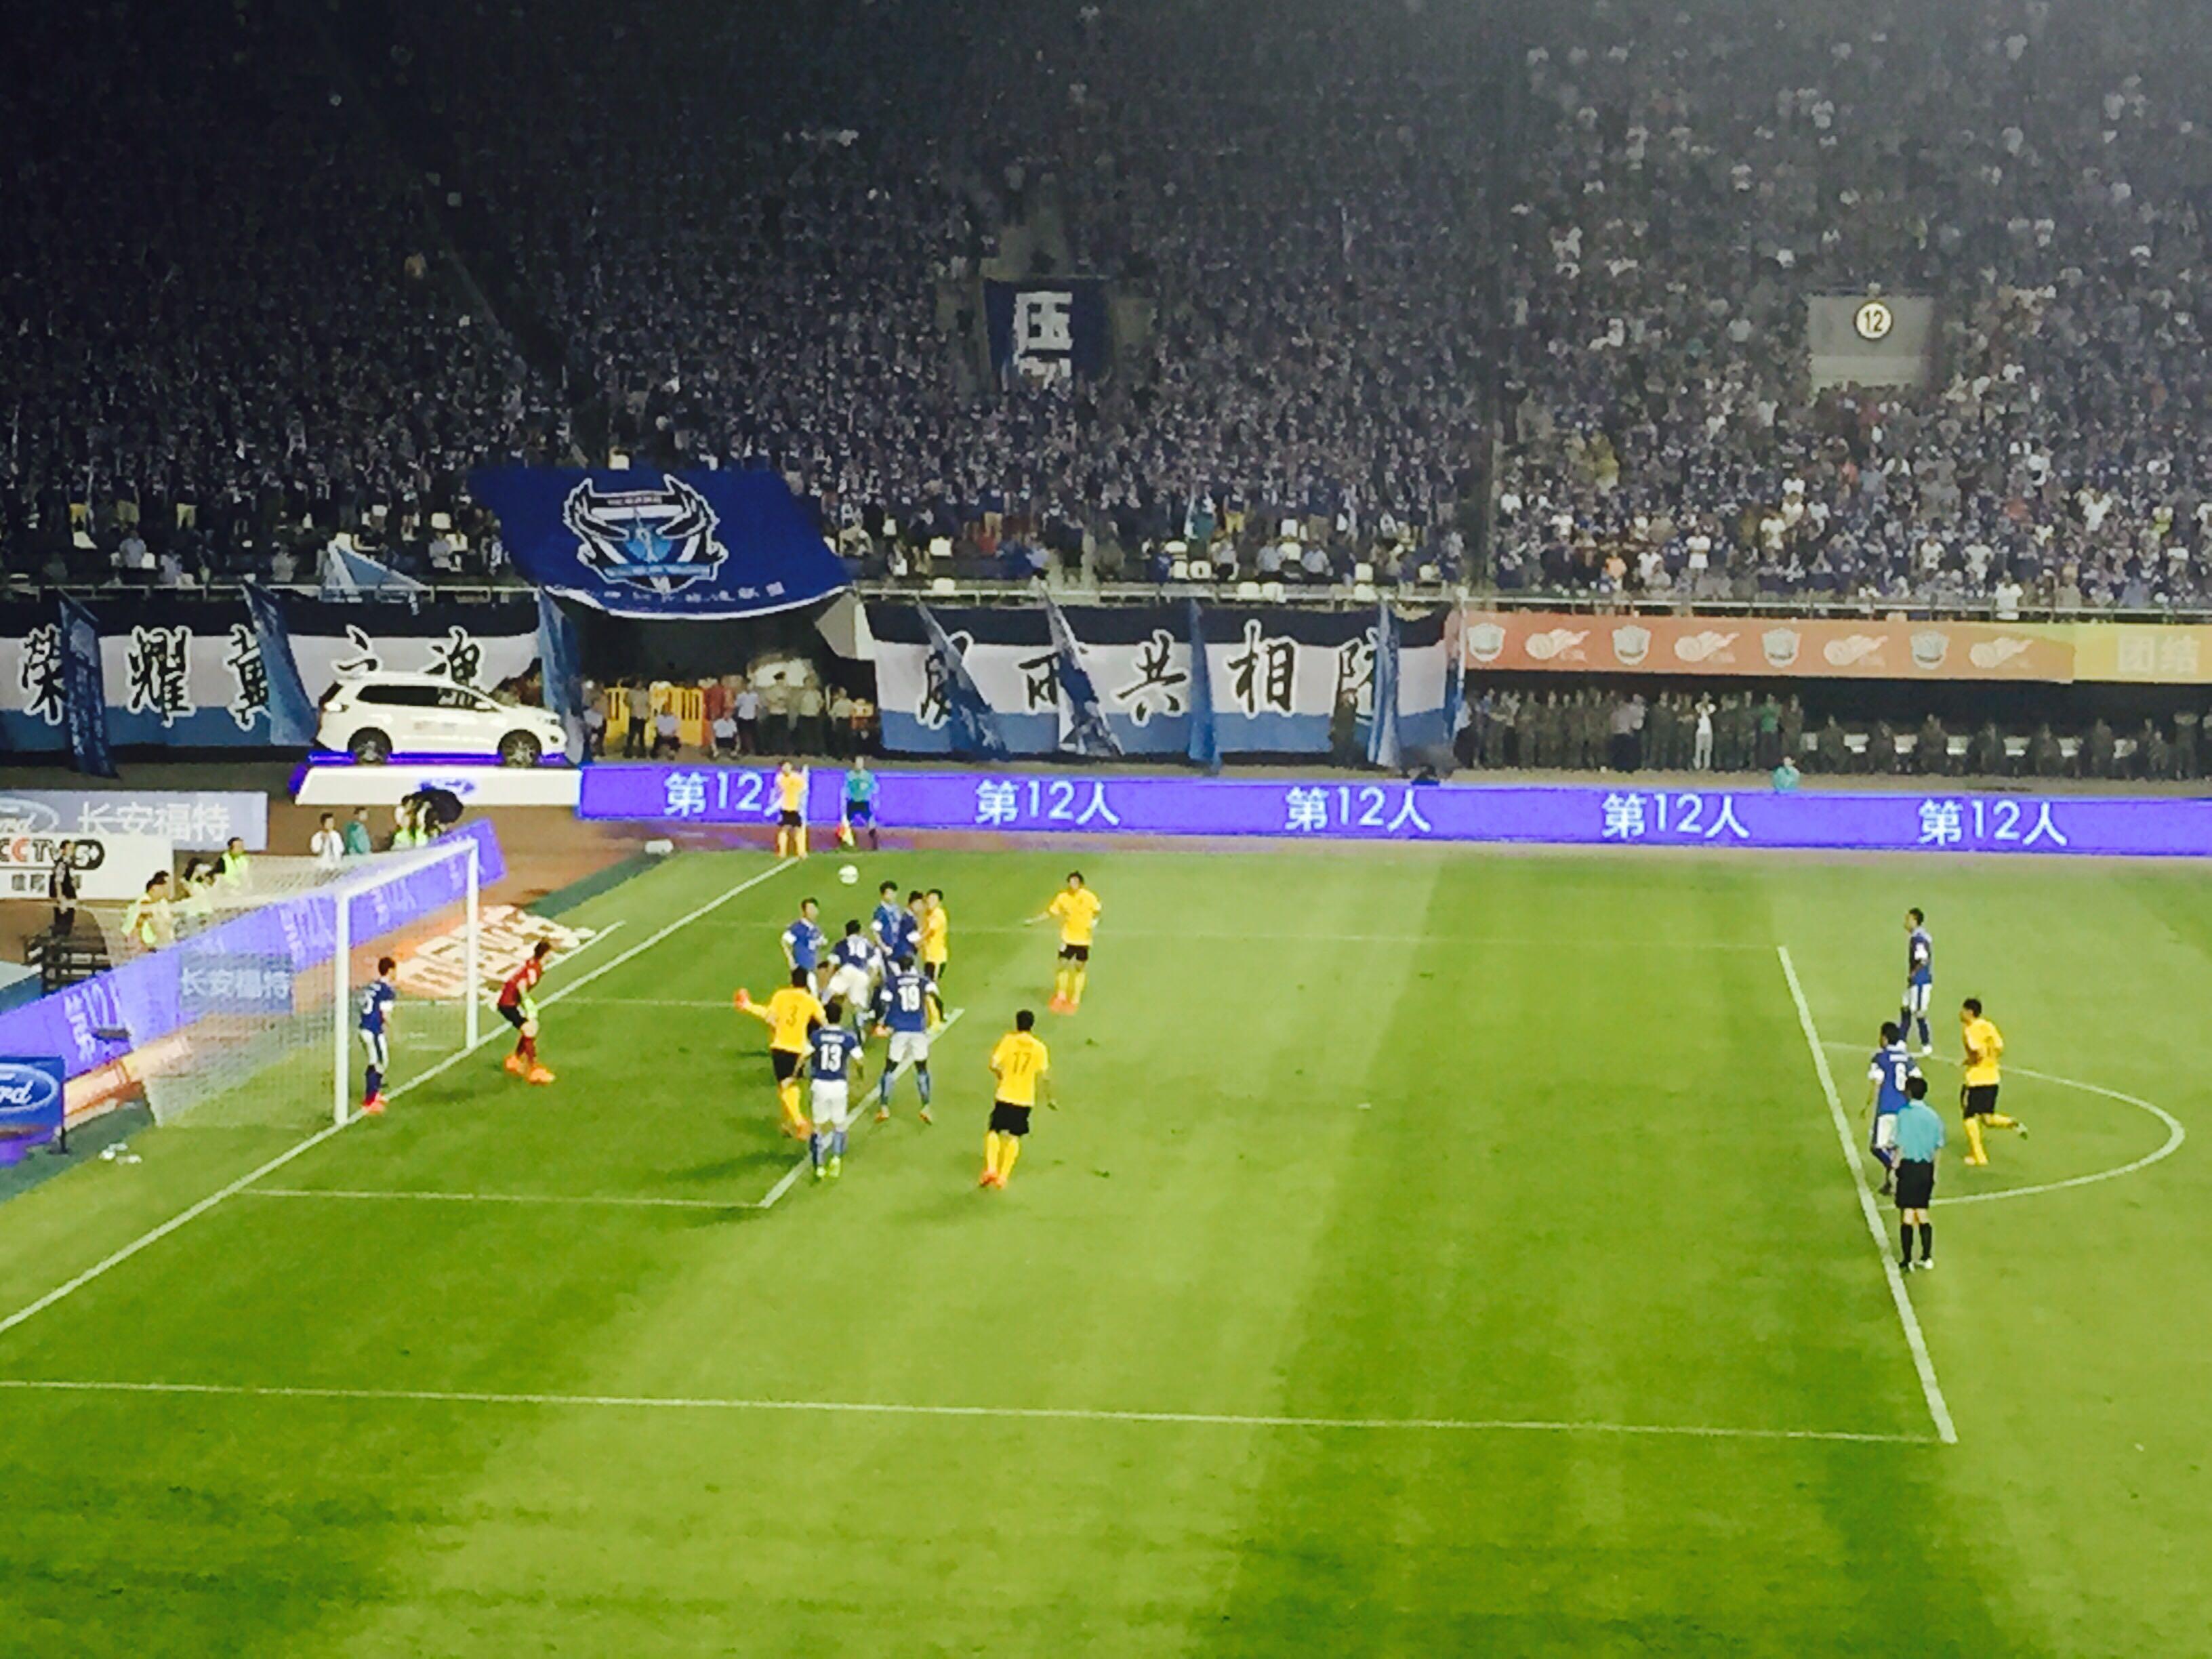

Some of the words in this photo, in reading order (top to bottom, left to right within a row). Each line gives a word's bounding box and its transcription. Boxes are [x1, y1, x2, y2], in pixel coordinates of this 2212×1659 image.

[1865, 310, 1884, 331] 12
[976, 779, 1120, 825] 第12人
[1286, 786, 1431, 832] 第12人
[1603, 793, 1749, 838] 第12人
[77, 802, 231, 842] 长安福特
[1919, 799, 2068, 846] 第12人
[785, 1003, 798, 1027] 3
[897, 983, 921, 1012] 19
[820, 1043, 843, 1073] 13
[1013, 1051, 1031, 1076] 17
